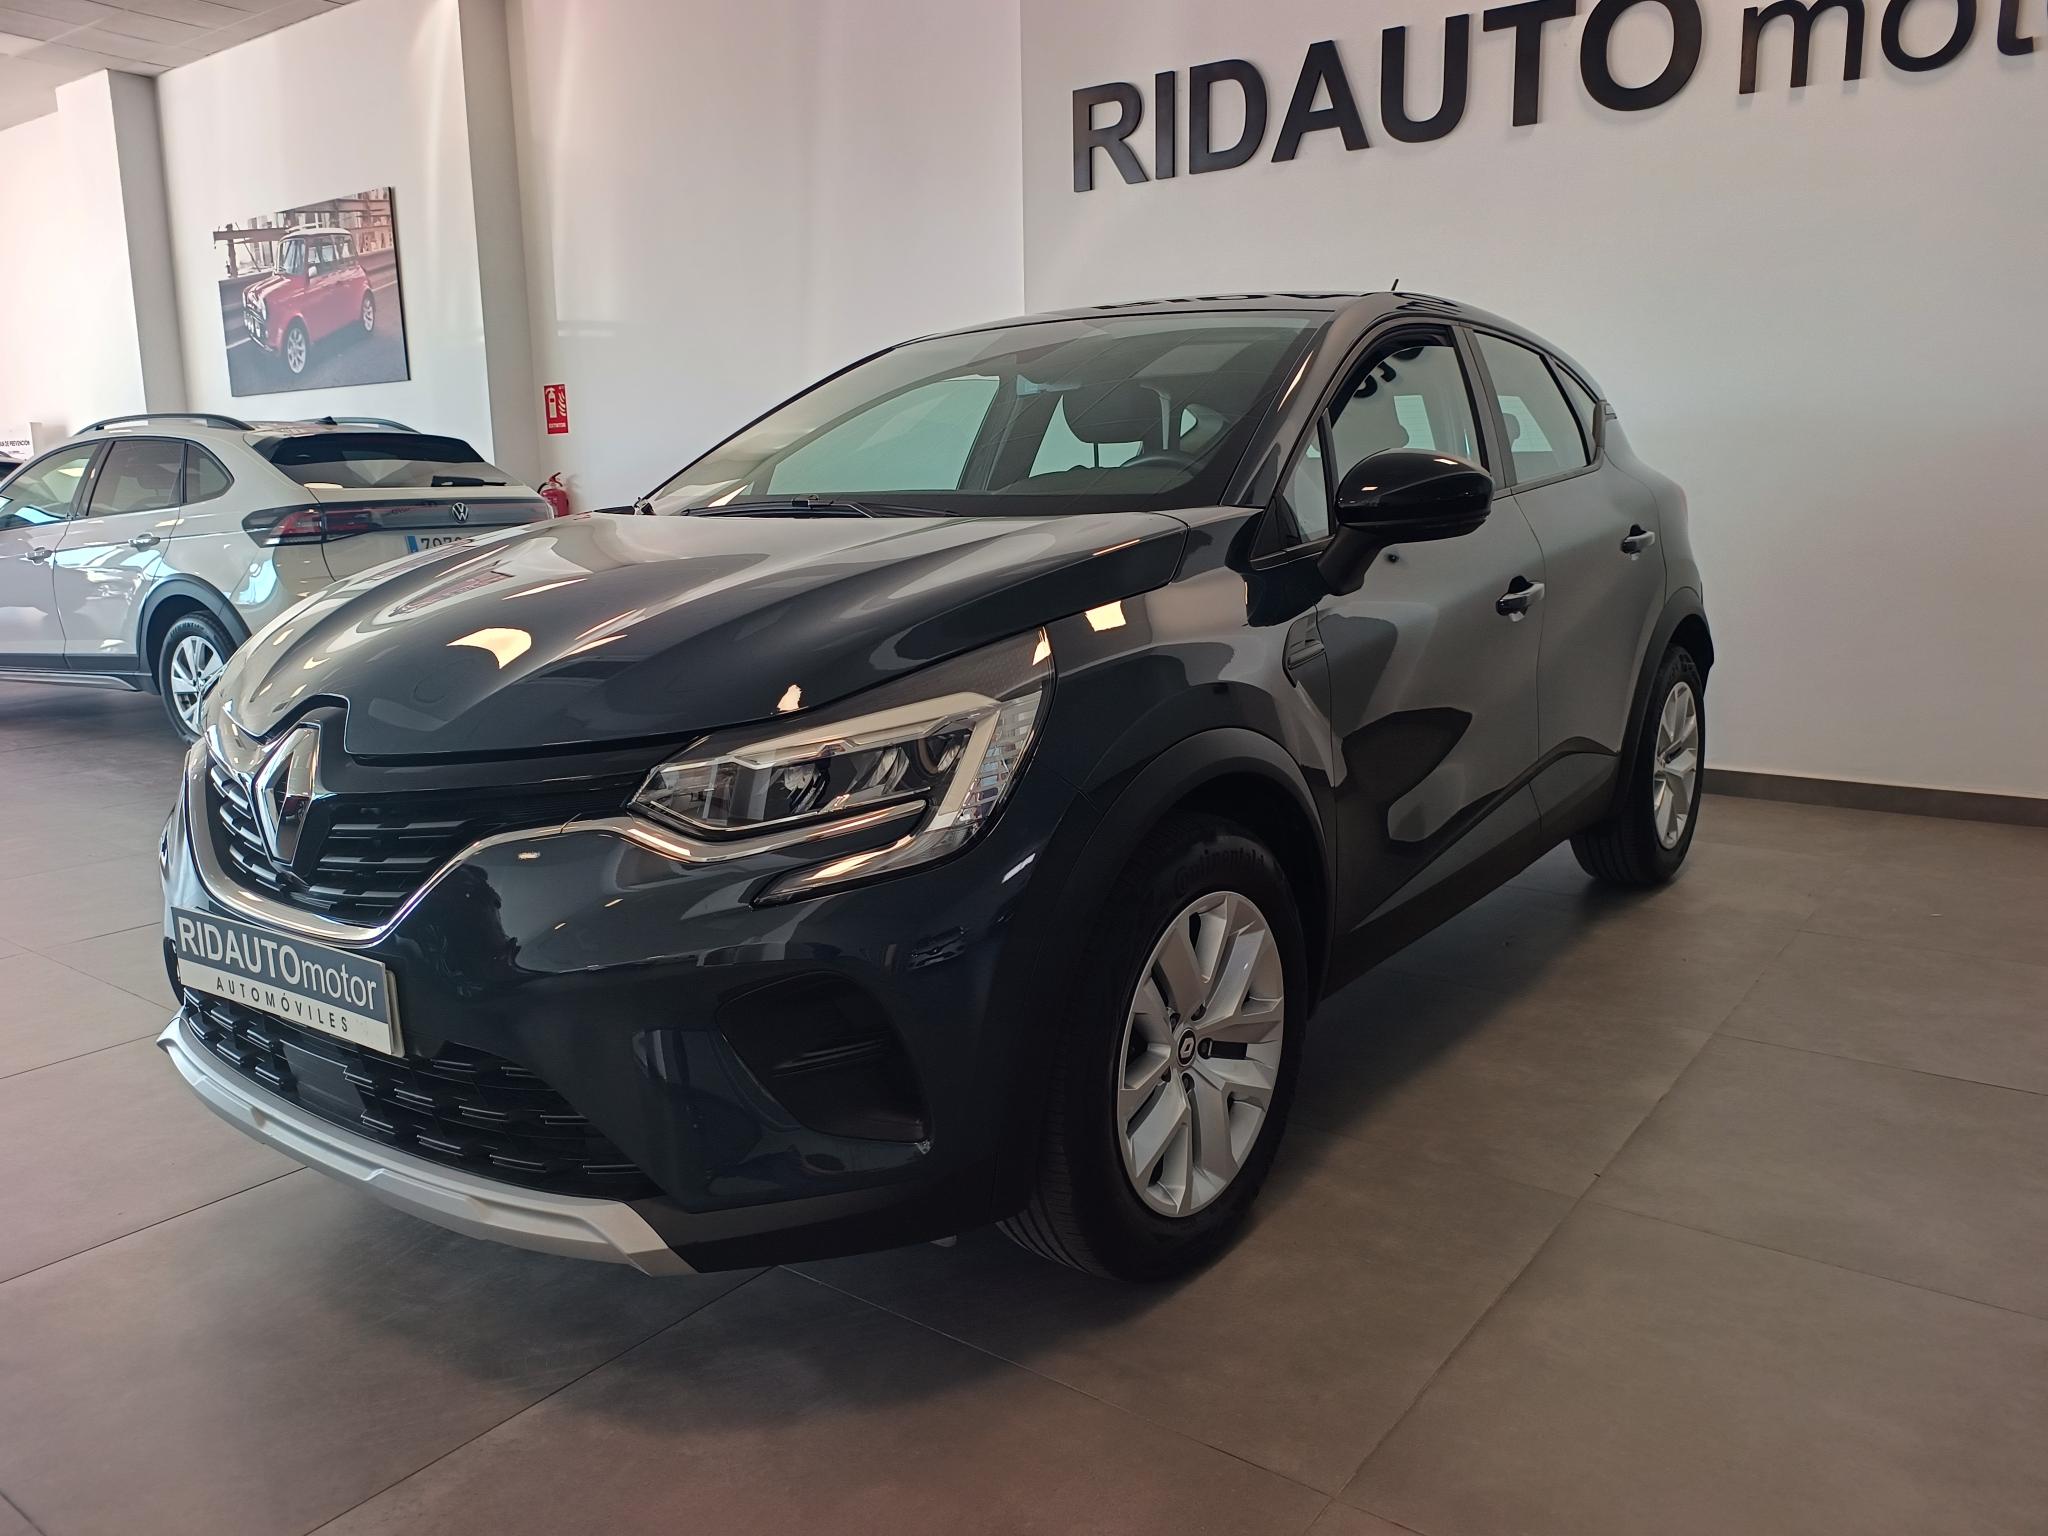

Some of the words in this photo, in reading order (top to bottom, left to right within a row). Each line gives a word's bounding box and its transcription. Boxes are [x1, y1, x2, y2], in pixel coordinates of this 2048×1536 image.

[1072, 0, 1703, 192] RIDAUTO
[178, 917, 377, 1010] RIDAUTOmotor
[216, 976, 348, 1032] AUTOMÓVILES
